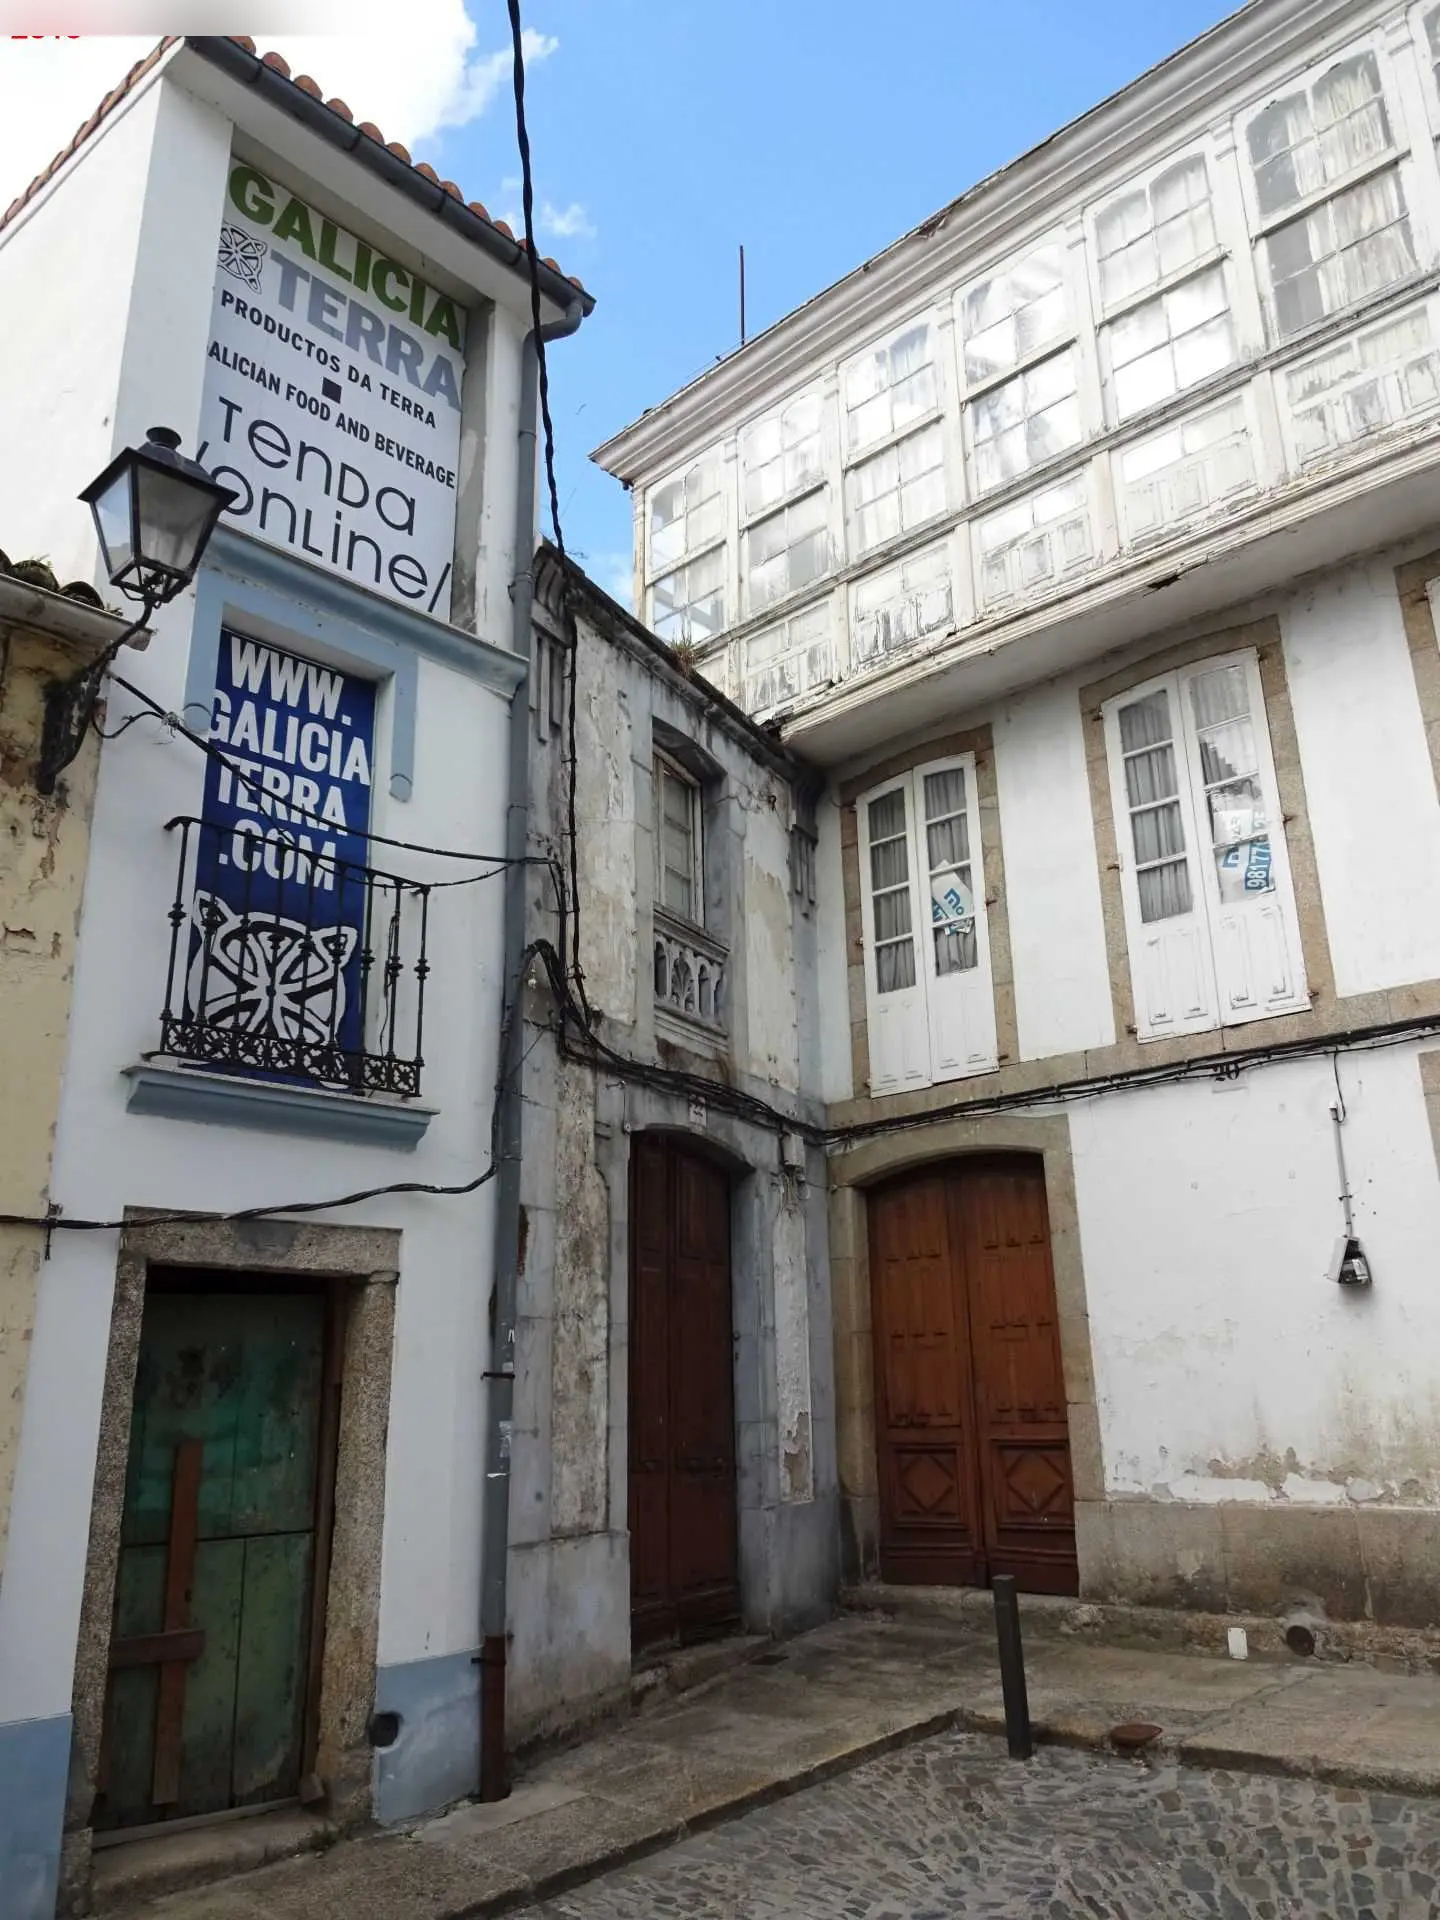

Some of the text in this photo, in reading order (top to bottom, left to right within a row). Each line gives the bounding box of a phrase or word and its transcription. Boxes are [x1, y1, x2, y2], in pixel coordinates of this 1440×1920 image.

[229, 165, 462, 352] GALICIA
[221, 288, 437, 429] PRODUCTOS DA TERRA
[270, 249, 461, 411] TERRA
[206, 340, 456, 489] ALICIAN FOOD AND BEVERAGE
[207, 688, 372, 786] GALICIA
[230, 635, 353, 727] WWW.
[215, 751, 349, 837] TERRA
[218, 818, 337, 892] .COM
